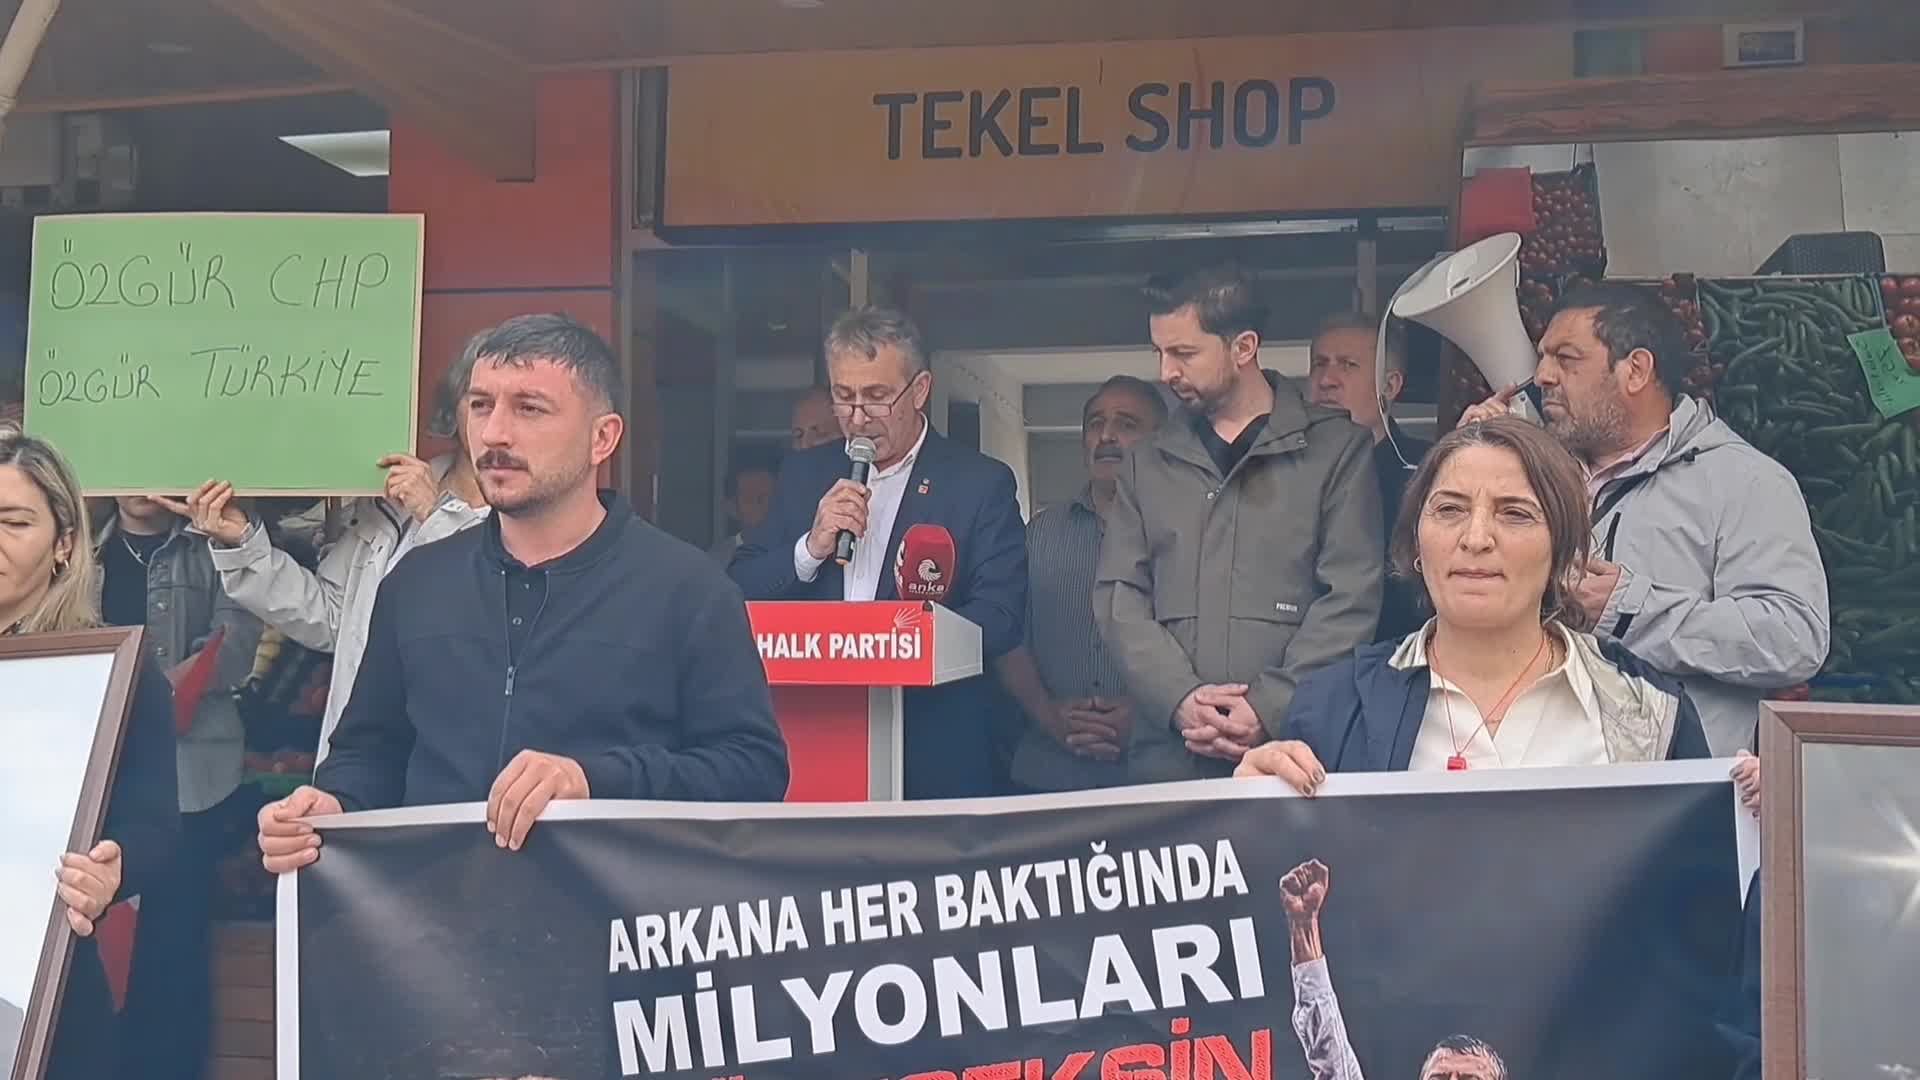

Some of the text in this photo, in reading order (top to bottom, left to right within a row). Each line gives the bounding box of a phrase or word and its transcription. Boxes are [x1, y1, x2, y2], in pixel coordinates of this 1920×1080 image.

[873, 76, 1336, 160] TEKEL SHOP
[270, 252, 389, 309] CHP
[190, 344, 384, 399] TÜRKİYE
[908, 581, 946, 593] anka
[757, 627, 921, 660] HALK PARTİSİ
[609, 839, 1249, 973] ARKANA HER BAKTIĞINDA
[613, 916, 1265, 1076] MİLYONLARI
